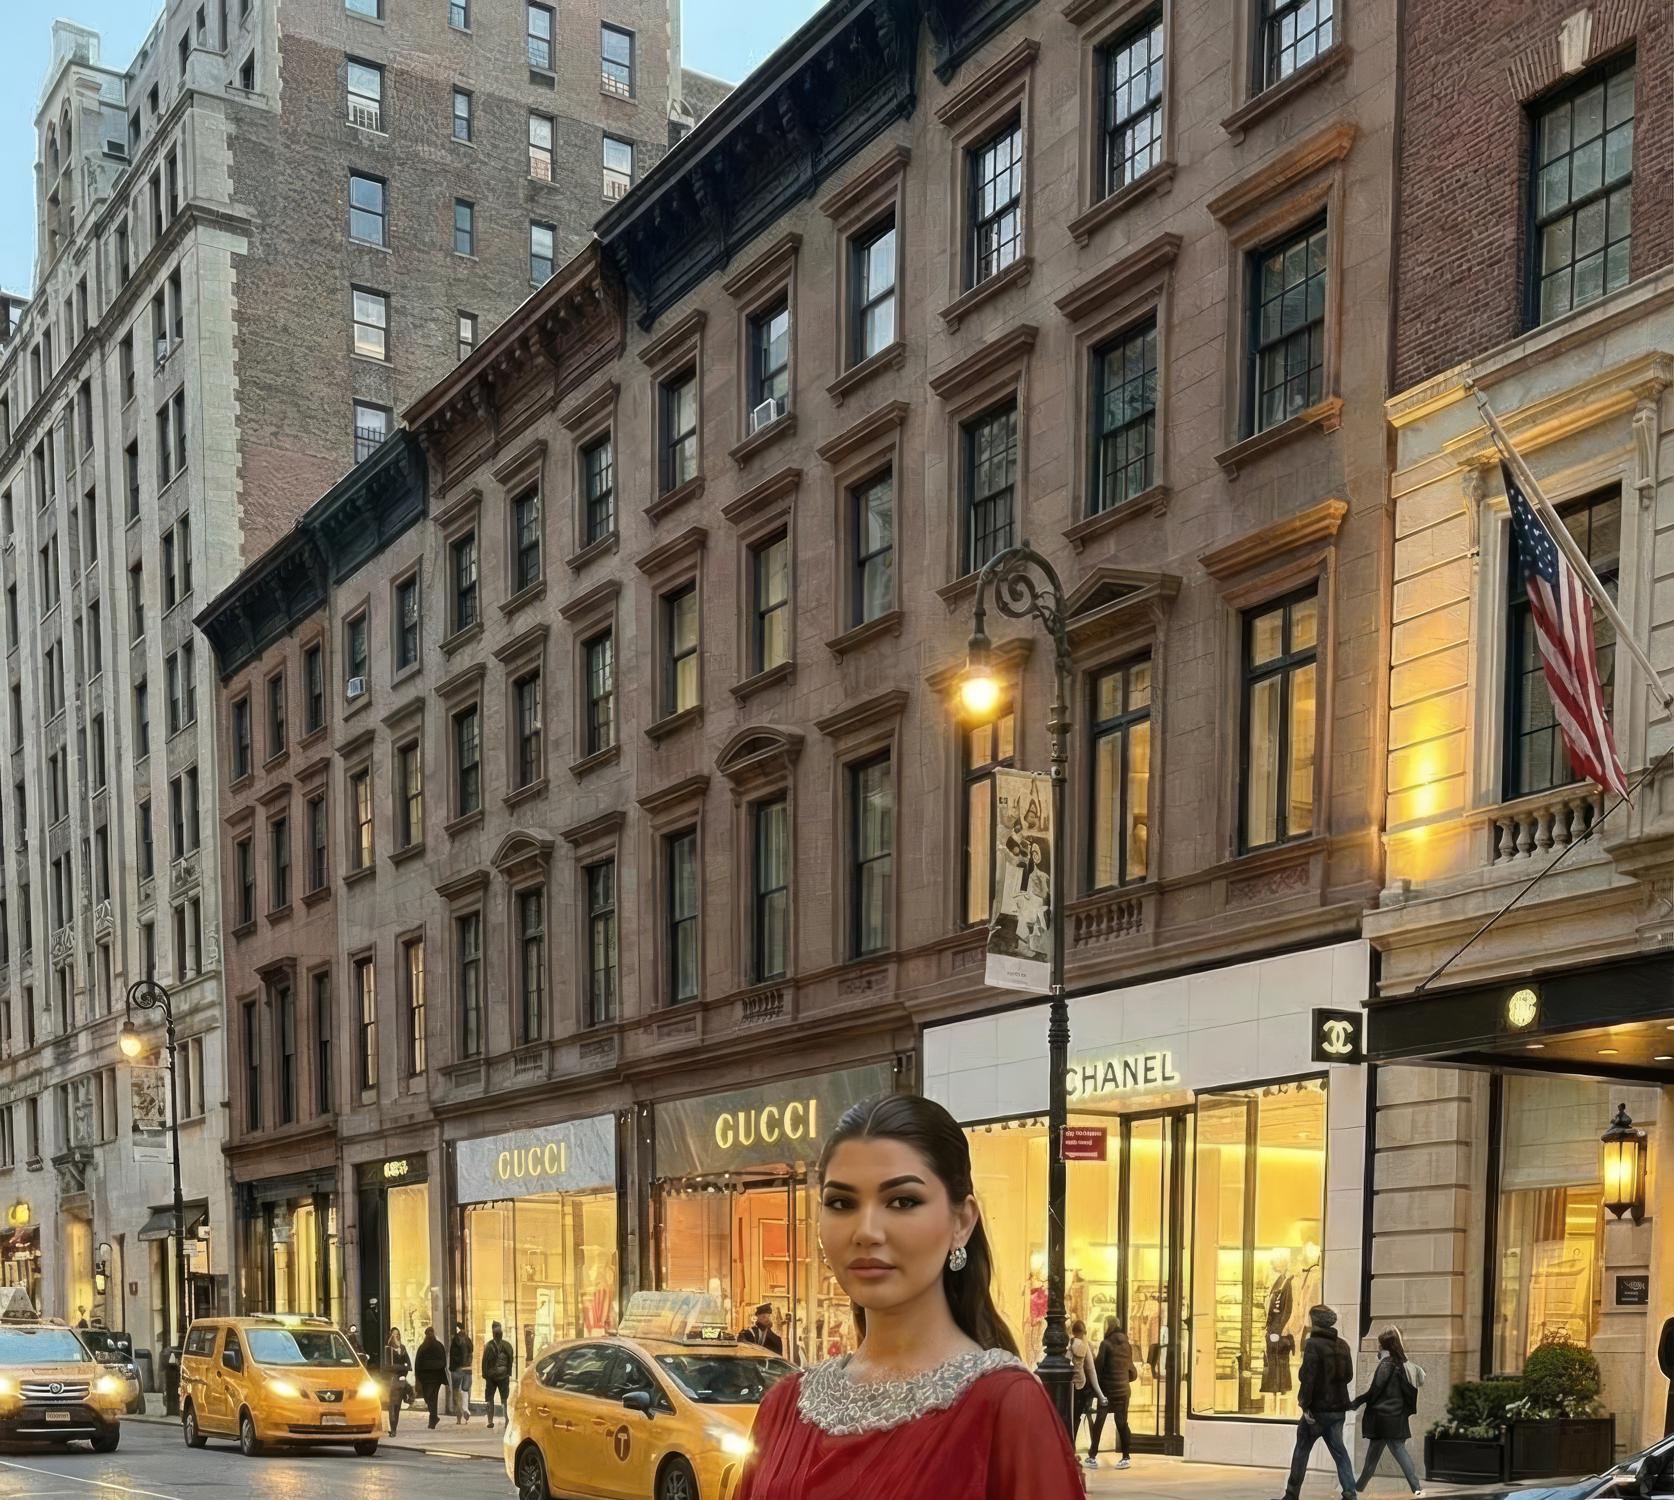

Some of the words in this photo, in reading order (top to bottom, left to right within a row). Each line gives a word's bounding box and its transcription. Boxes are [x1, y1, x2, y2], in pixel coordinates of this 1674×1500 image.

[1065, 1053, 1175, 1097] CHANEL
[715, 1099, 817, 1149] GUCCI
[617, 1432, 628, 1457] T
